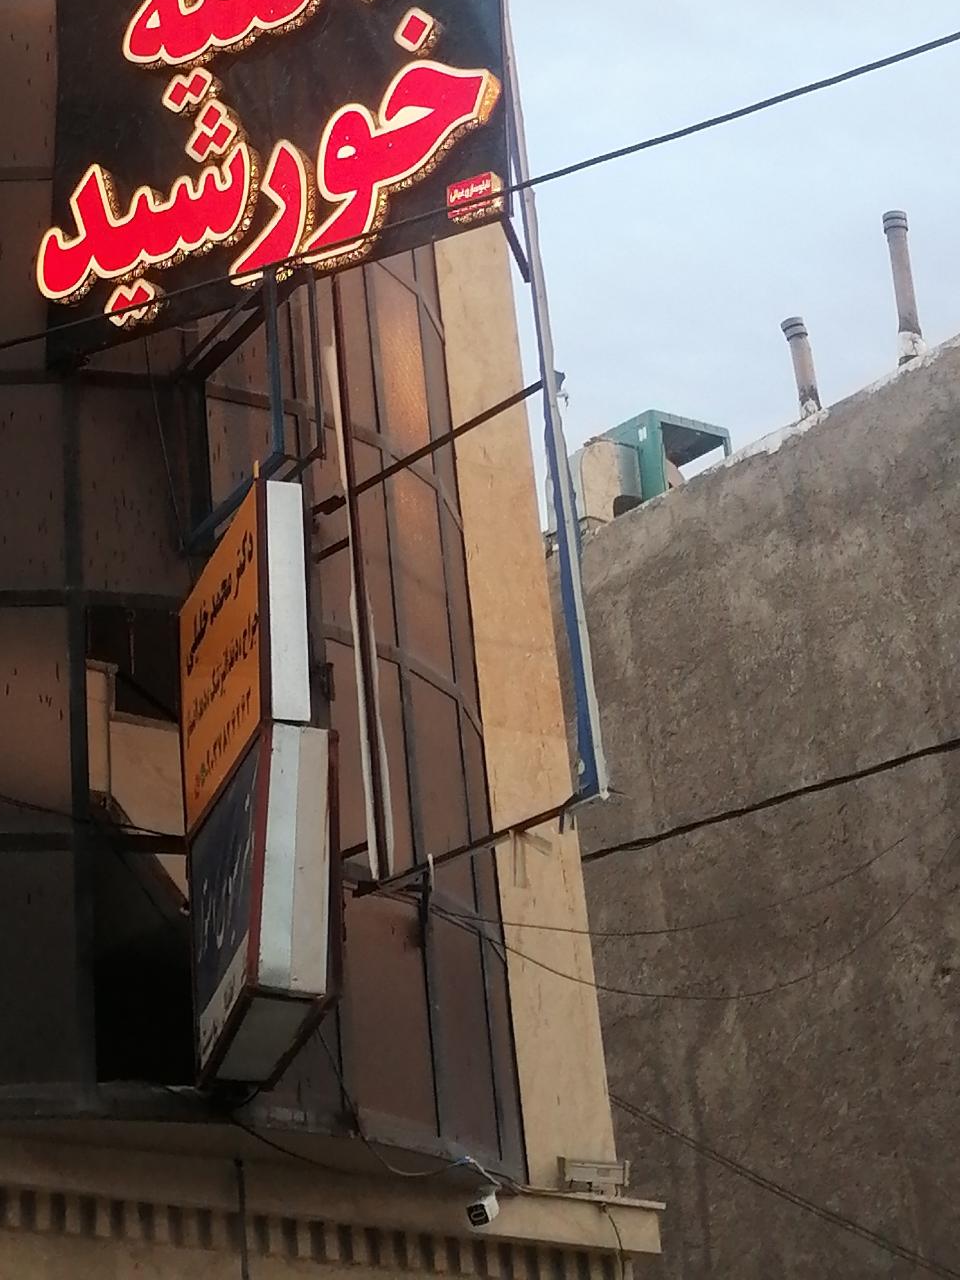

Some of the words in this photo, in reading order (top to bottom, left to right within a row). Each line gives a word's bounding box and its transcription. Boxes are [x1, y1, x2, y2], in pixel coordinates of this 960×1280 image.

[37, 6, 492, 326] خورشید
[210, 572, 232, 626] محمد
[233, 529, 253, 601] دکتر
